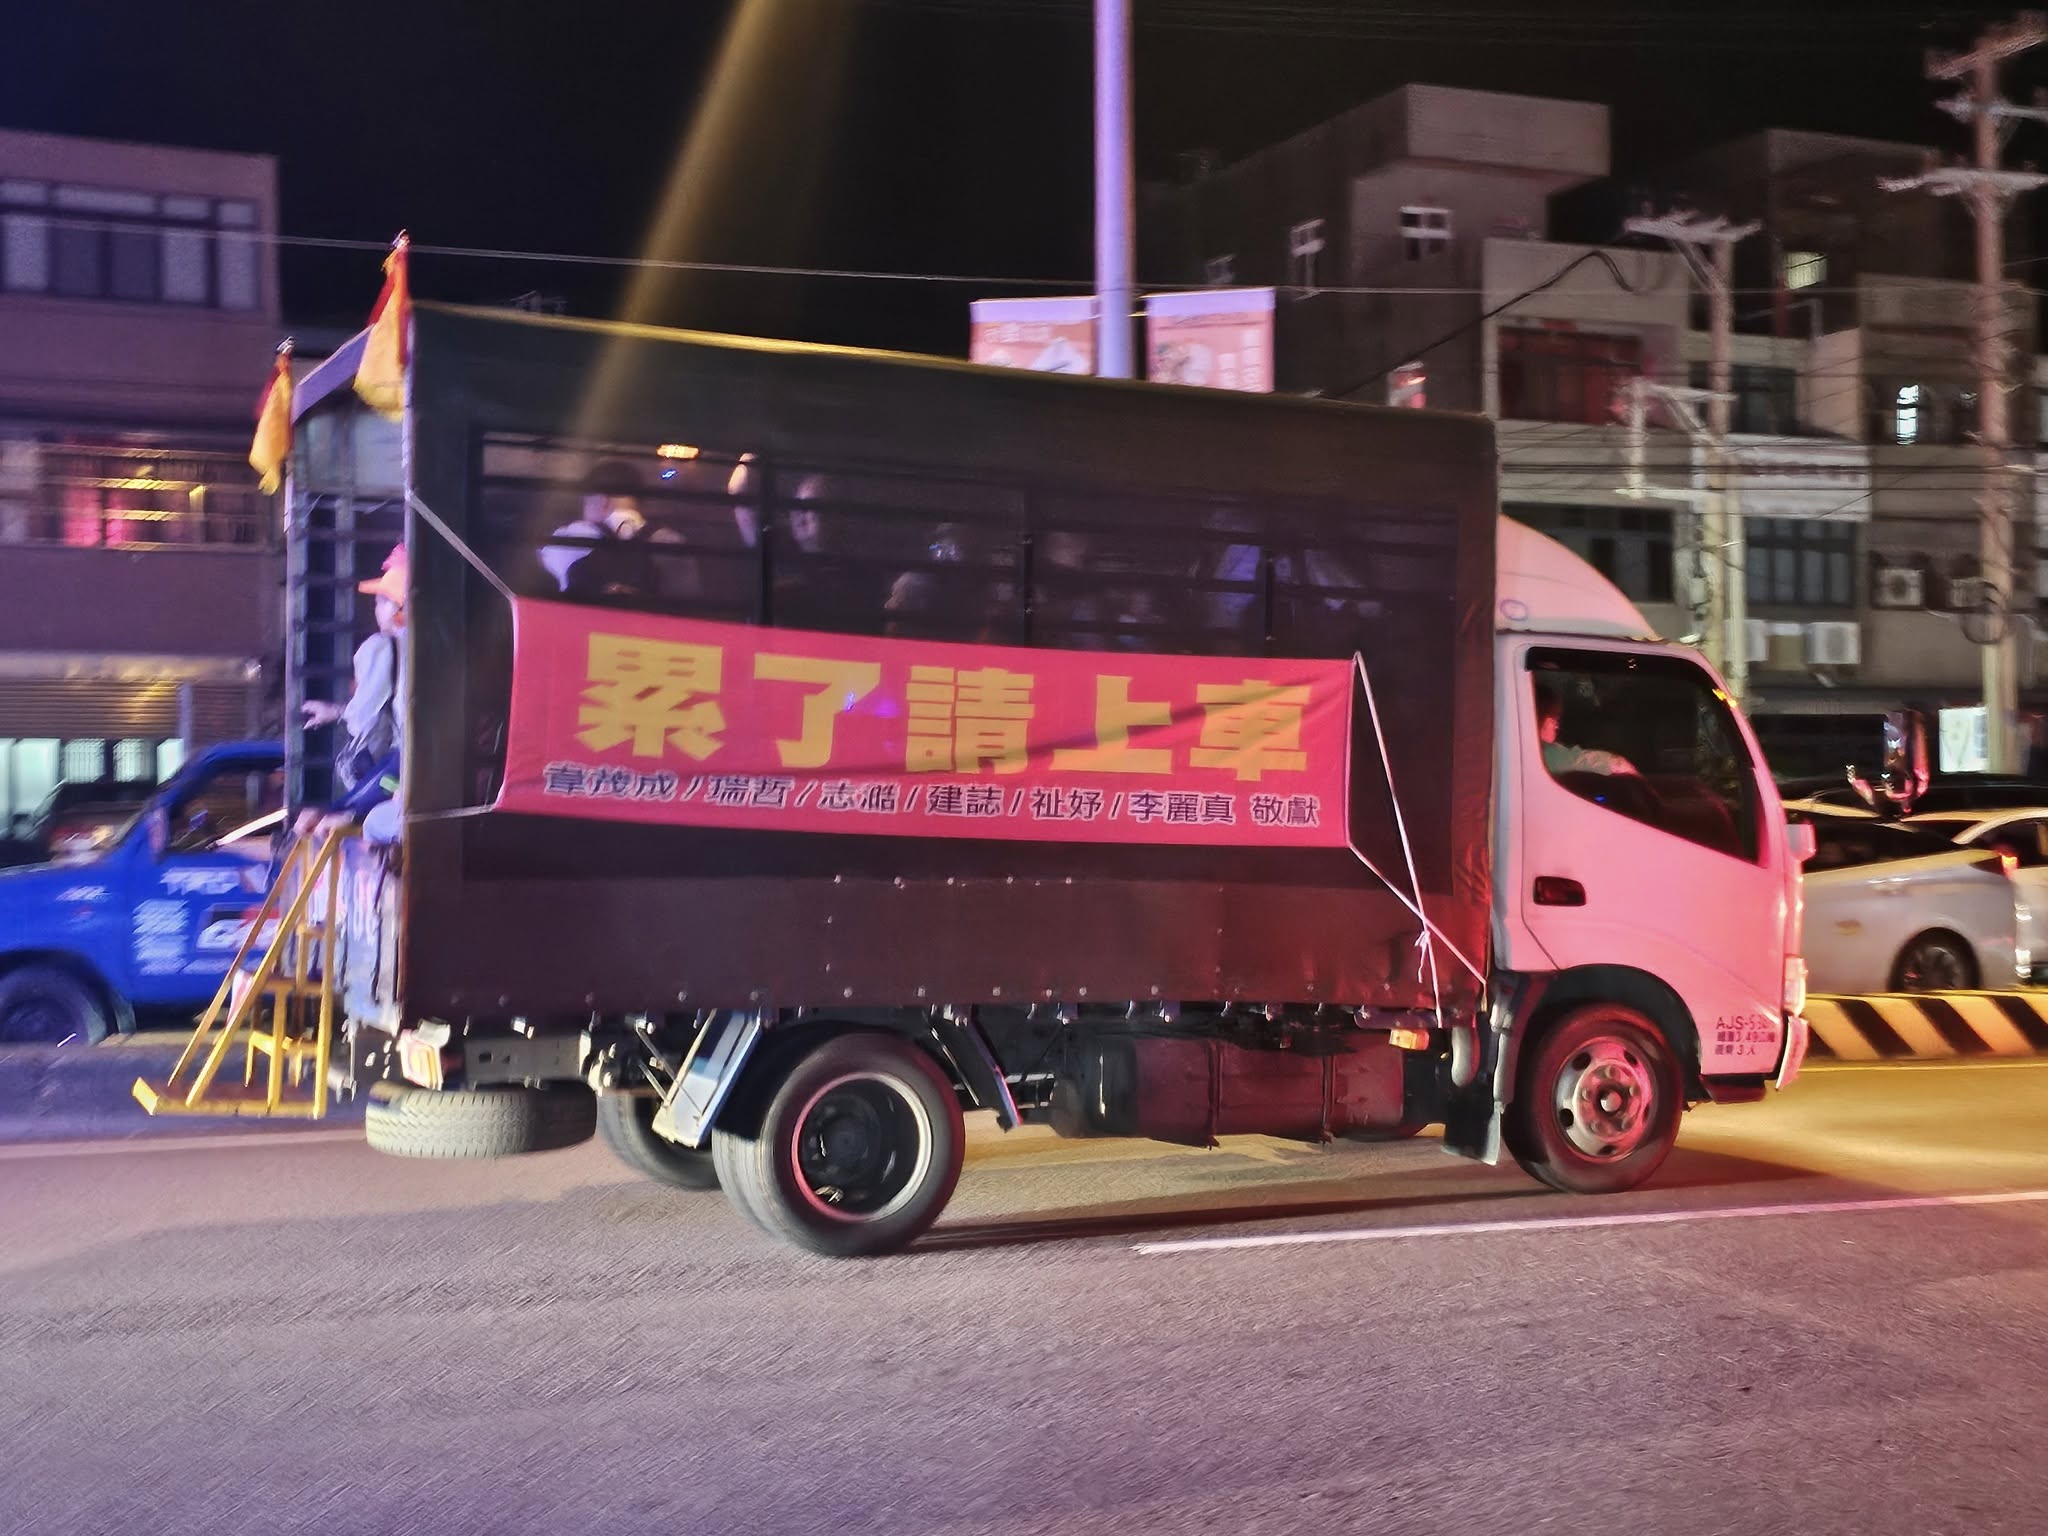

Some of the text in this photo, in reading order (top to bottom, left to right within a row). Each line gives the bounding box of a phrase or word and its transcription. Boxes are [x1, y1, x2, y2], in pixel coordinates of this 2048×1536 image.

[573, 632, 1311, 781] 累了請上車
